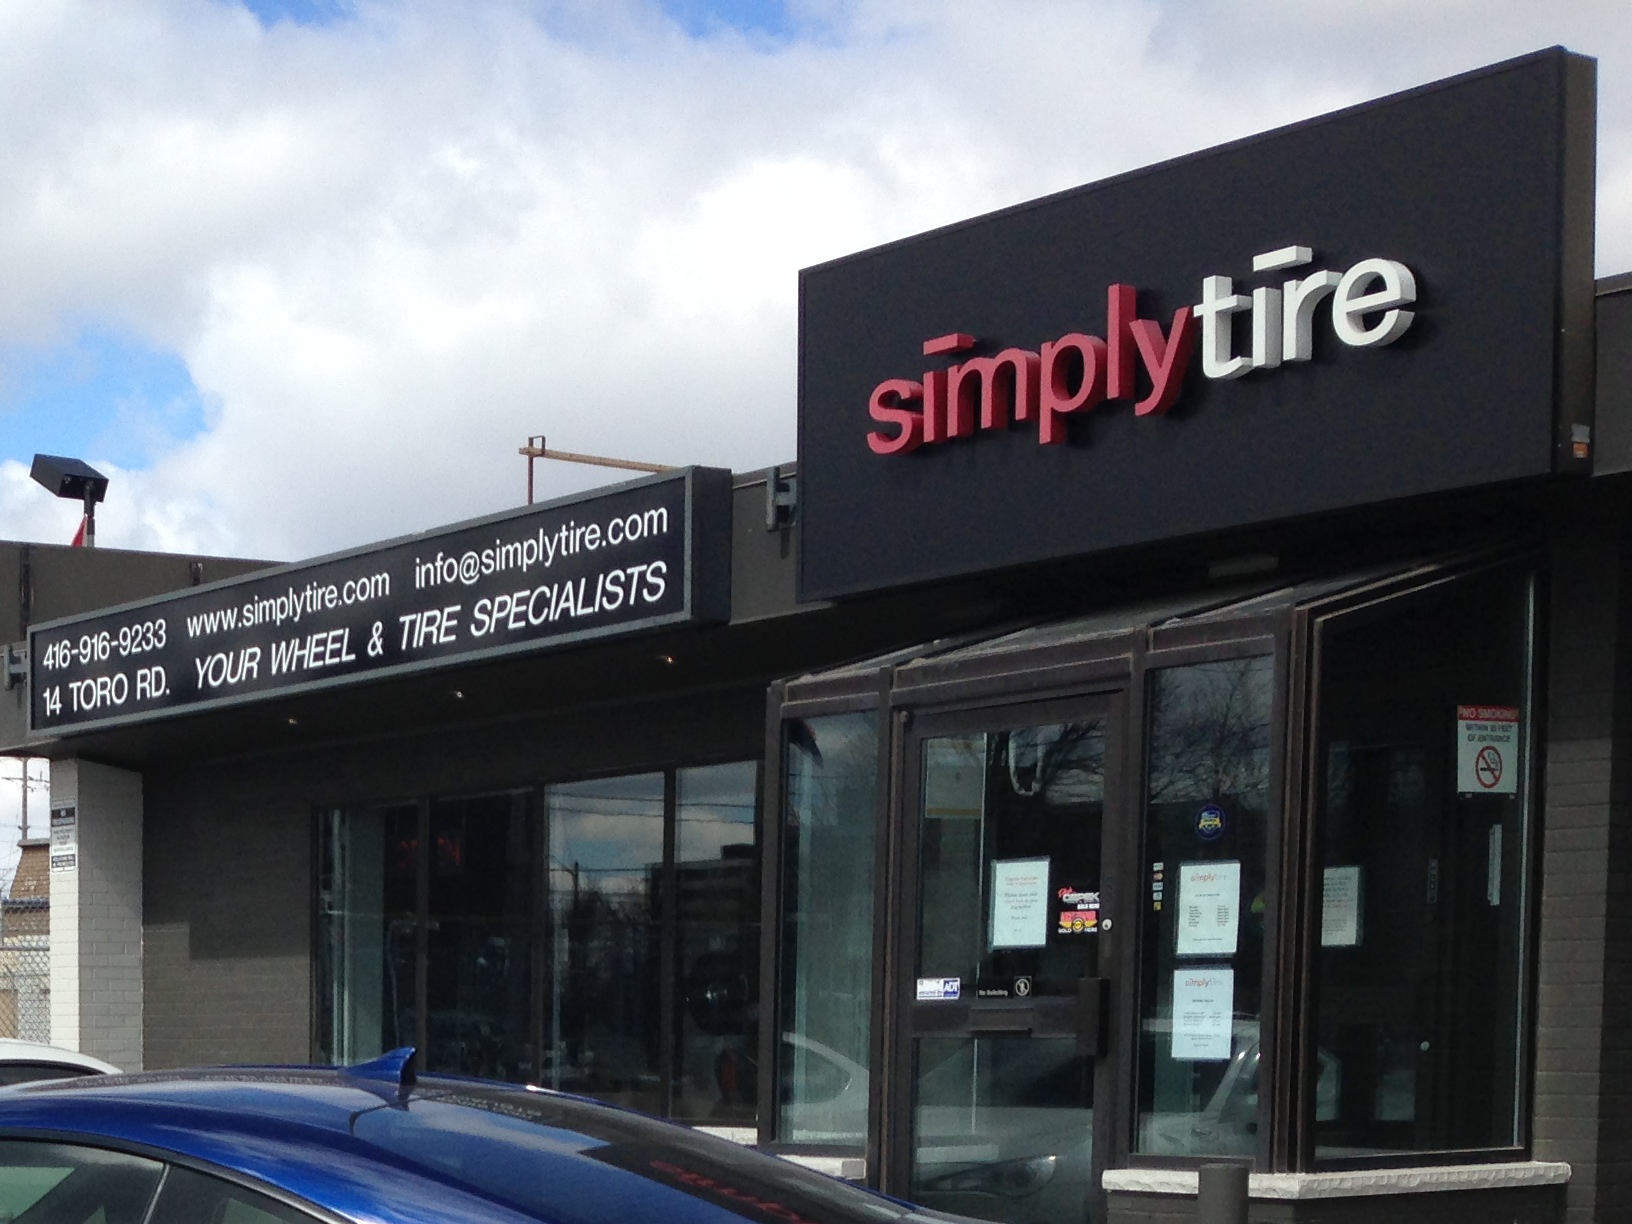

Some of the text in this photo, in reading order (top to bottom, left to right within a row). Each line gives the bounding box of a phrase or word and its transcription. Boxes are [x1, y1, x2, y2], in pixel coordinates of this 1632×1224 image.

[867, 245, 1416, 454] simplytire
[43, 507, 667, 670] 416-916-9233 www.simplytire.com info@simplytire.com
[43, 560, 667, 717] 14 TORO RD. YOUR WHEEL & TIRE SPECIALISTS
